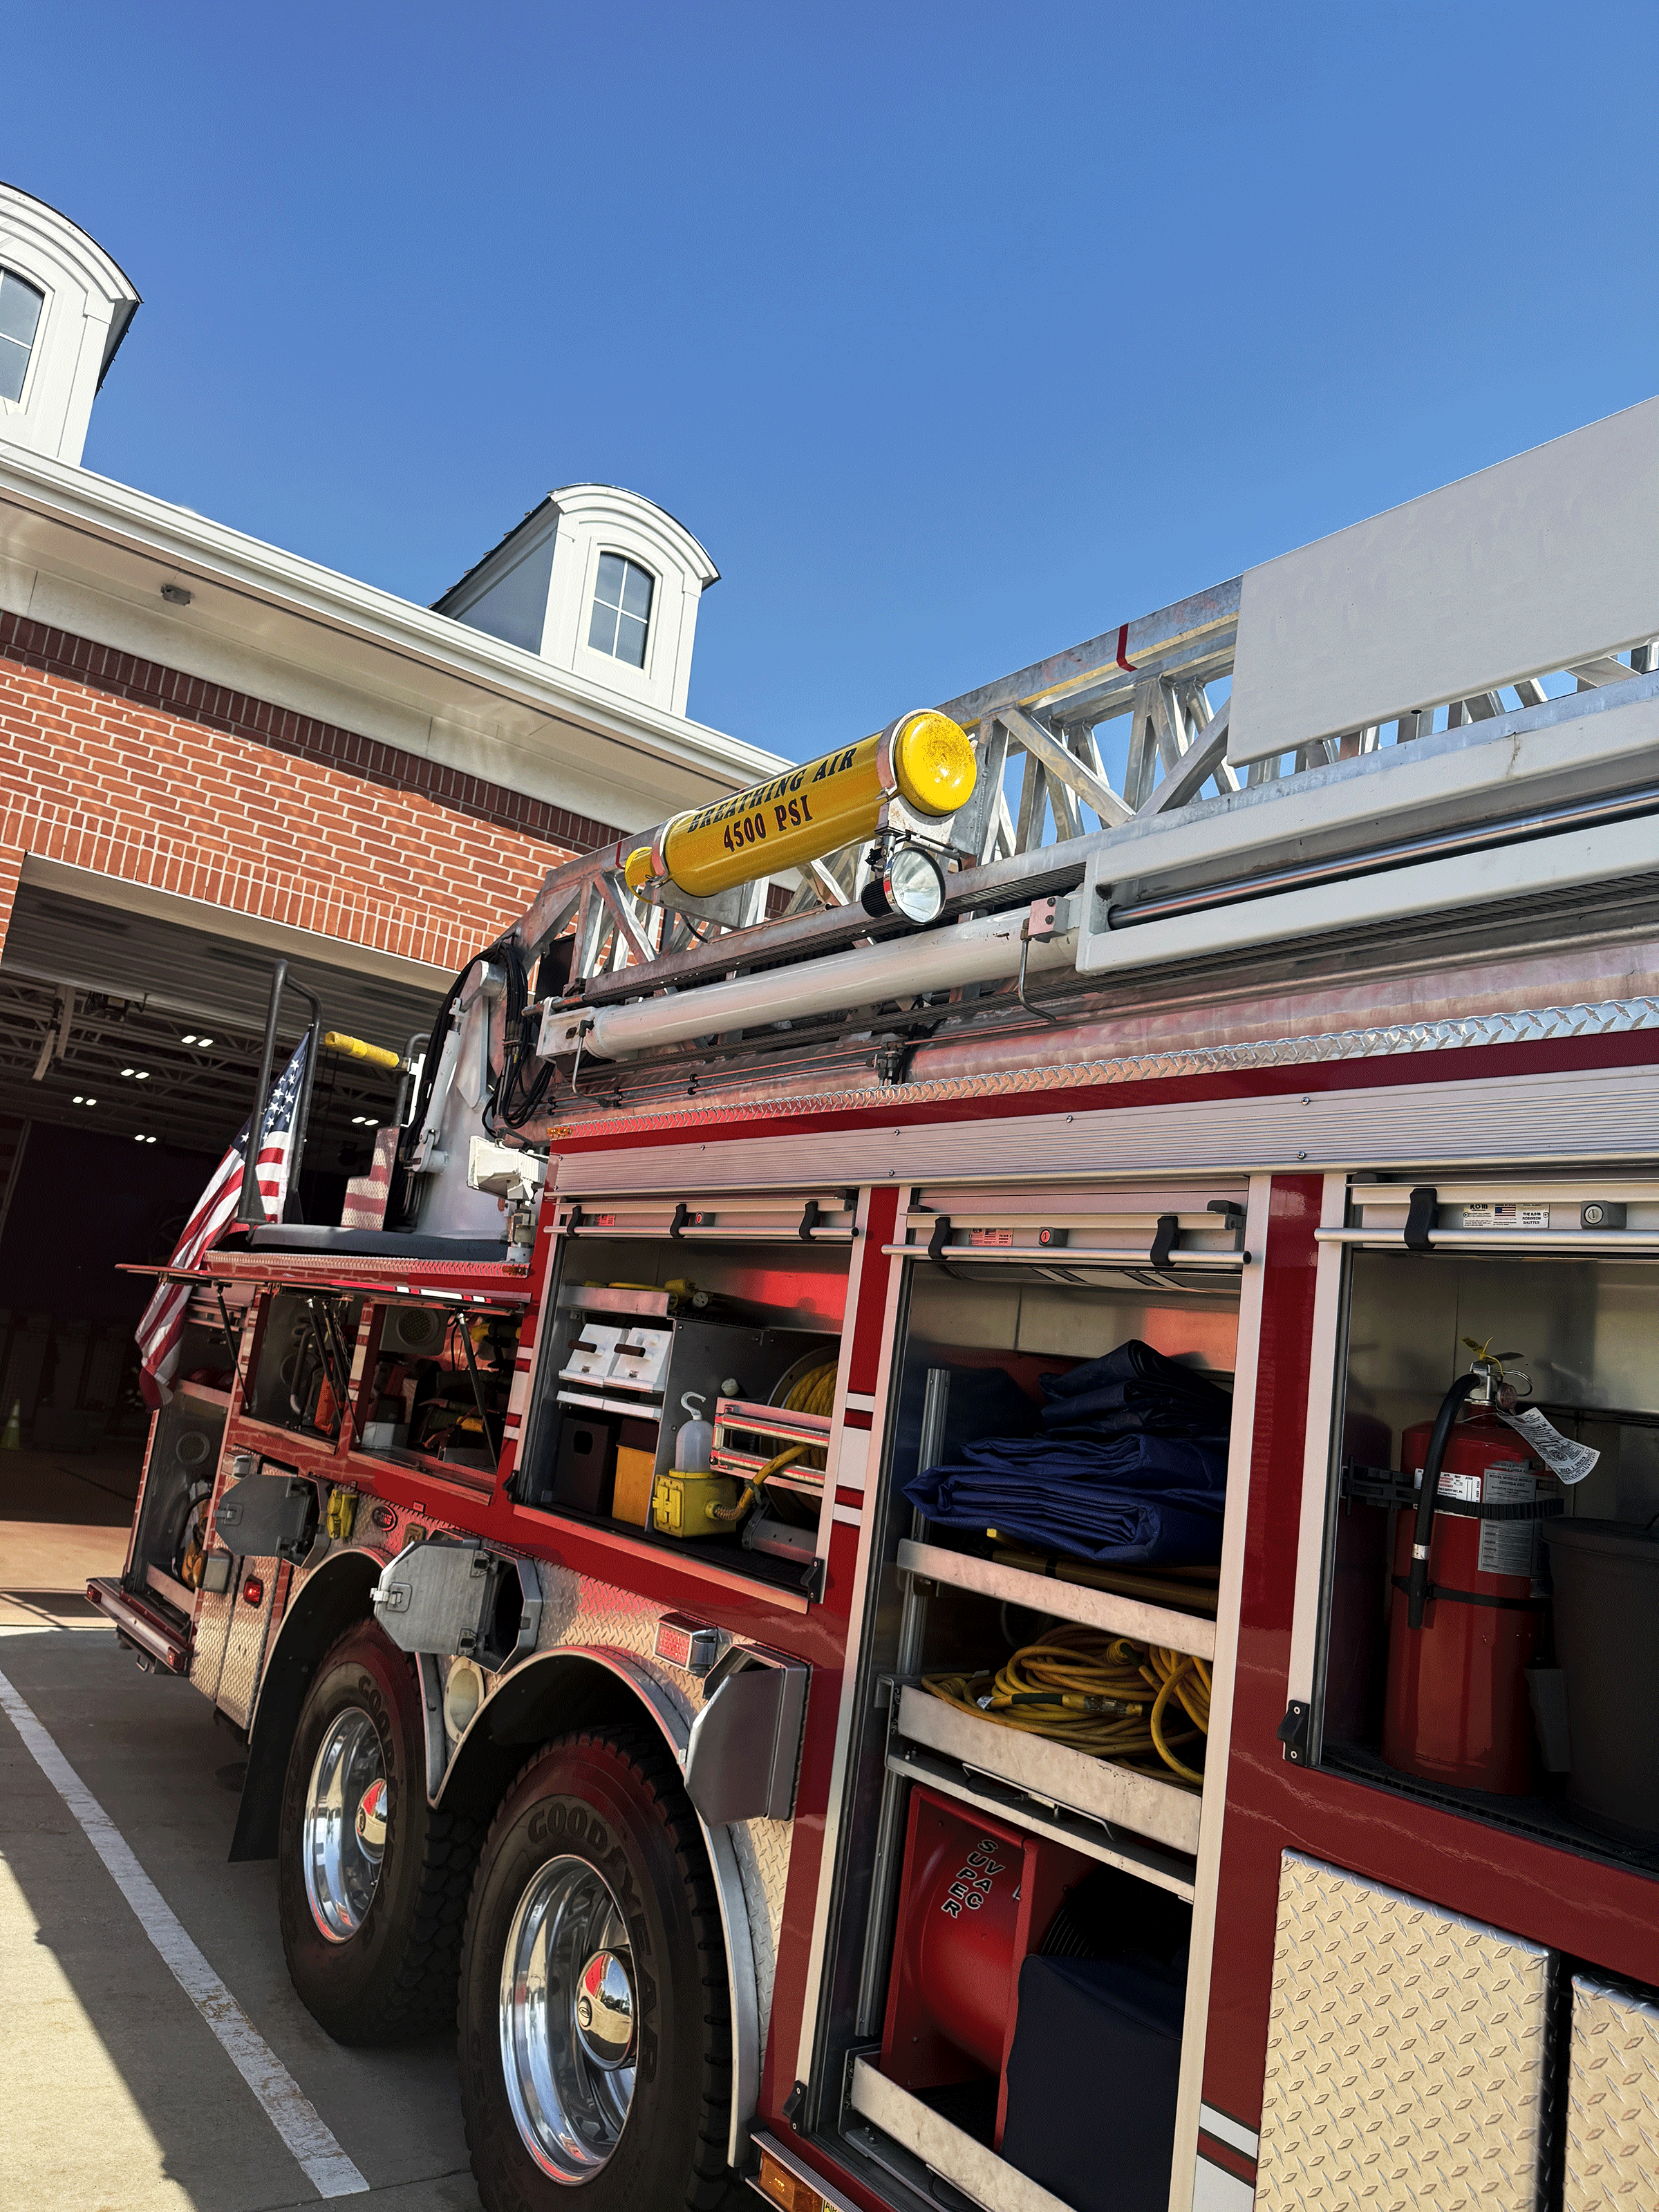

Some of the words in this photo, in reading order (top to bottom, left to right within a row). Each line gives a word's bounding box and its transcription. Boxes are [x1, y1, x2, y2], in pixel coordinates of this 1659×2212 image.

[687, 767, 807, 834] BREATHING
[812, 747, 857, 784] AIR
[723, 812, 767, 852] 4500
[774, 794, 813, 832] PSI
[941, 1839, 999, 1919] SUPER
[964, 1859, 1006, 1910] VAC
